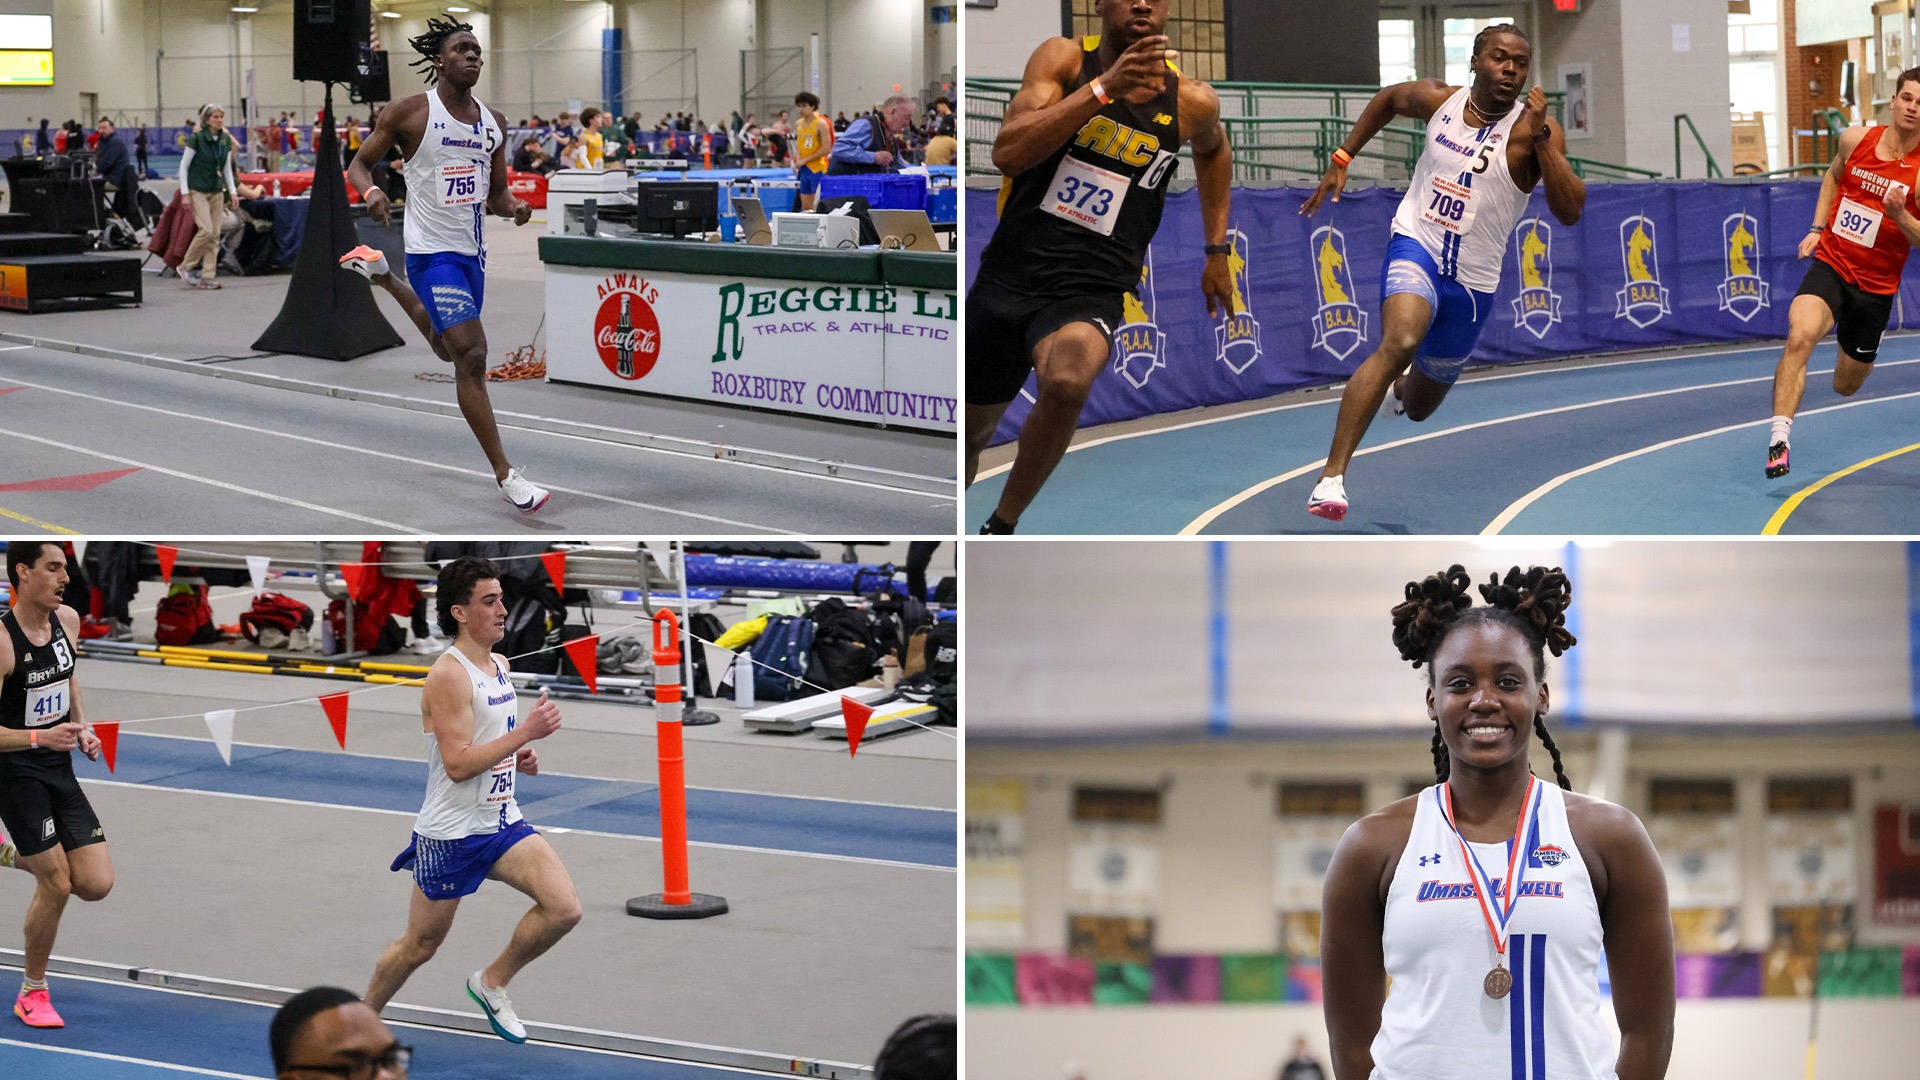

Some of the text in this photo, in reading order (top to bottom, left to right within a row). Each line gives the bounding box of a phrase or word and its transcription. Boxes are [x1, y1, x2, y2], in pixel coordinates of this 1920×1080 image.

[485, 128, 496, 153] 5
[1074, 115, 1160, 167] AIC
[1472, 145, 1495, 174] 5
[1148, 155, 1173, 187] 6
[1851, 166, 1891, 188] BRIDGEWA
[444, 175, 476, 196] 755
[1057, 176, 1114, 216] 373
[1860, 180, 1885, 196] STATE
[1067, 207, 1098, 225] ATHLETIC
[1429, 189, 1466, 221] 709
[1433, 217, 1460, 231] ATHLETIC
[1840, 210, 1873, 235] 397
[597, 273, 659, 305] ALWAYS
[1630, 286, 1658, 303] B.A.A.
[1731, 280, 1758, 296] B.A.A.
[1525, 293, 1548, 310] B.A.A.
[711, 282, 897, 363] REGGIE
[1325, 309, 1356, 329] B.A.A.
[753, 321, 949, 341] TRACK & ATHLETIC
[1122, 330, 1153, 352] B.A.A.
[711, 371, 957, 424] ROXBURY COMMUNITY
[56, 642, 70, 668] 3
[33, 692, 62, 715] 411
[490, 771, 513, 794] 754
[1533, 850, 1570, 860] AMERICA
[1490, 877, 1564, 899] LWELL
